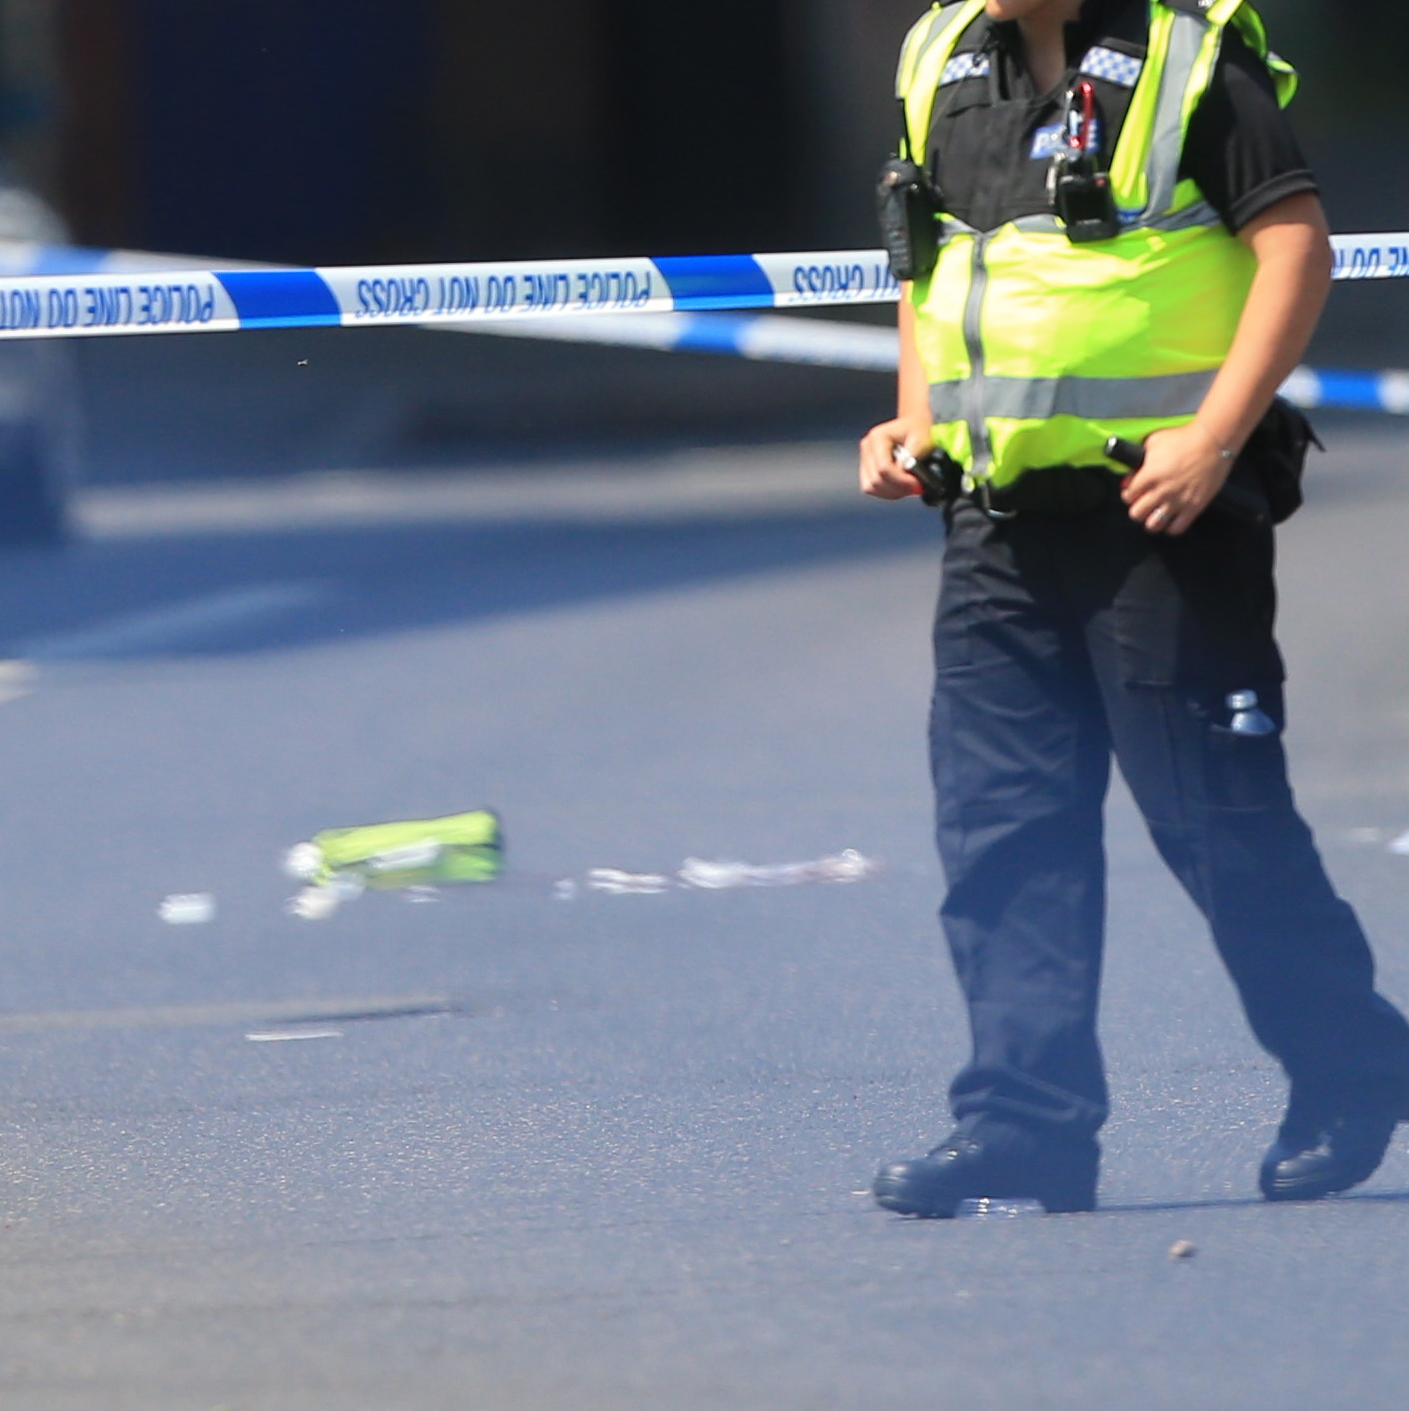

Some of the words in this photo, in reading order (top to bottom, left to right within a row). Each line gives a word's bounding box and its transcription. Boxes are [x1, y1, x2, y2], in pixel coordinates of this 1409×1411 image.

[1350, 248, 1379, 277] DO
[0, 289, 40, 329] NOT
[49, 289, 78, 328] DO
[86, 286, 131, 327] LINE
[140, 283, 216, 324] POLICE
[356, 279, 429, 317] CROSS
[435, 277, 480, 314] NOT
[487, 276, 516, 312] DO
[521, 274, 571, 311] LINE
[575, 271, 650, 310] POLICE
